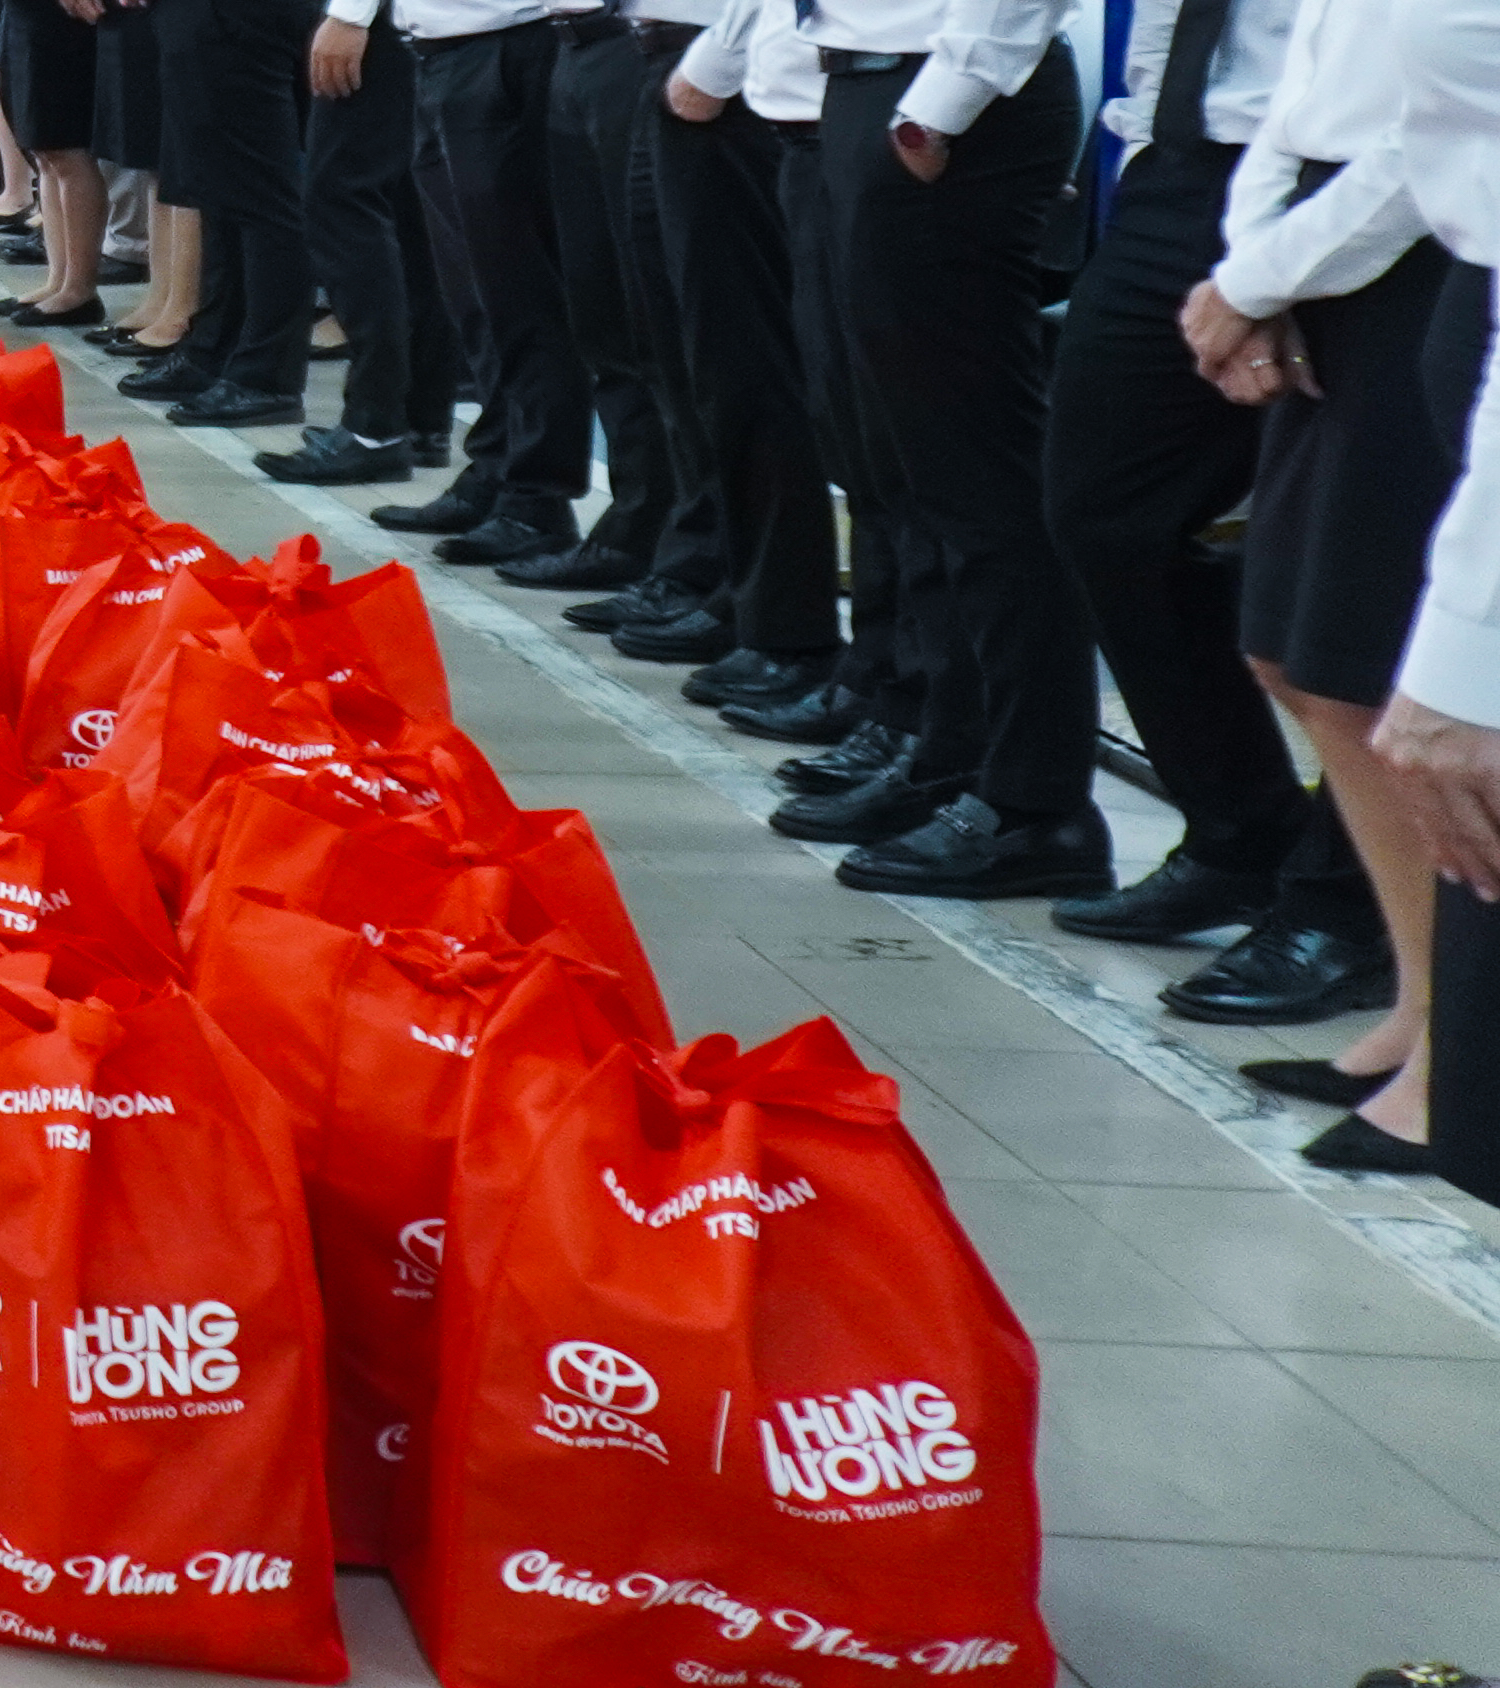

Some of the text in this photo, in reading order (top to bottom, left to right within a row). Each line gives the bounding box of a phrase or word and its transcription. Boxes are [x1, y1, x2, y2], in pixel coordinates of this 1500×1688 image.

[76, 1299, 240, 1355] HÙNG
[182, 1397, 245, 1417] GROUP
[540, 1393, 668, 1456] TOYOTA
[777, 1380, 957, 1452] HÙNG
[774, 1500, 852, 1523] TOYOTA
[920, 1488, 984, 1510] GROUP
[63, 1553, 179, 1597] Năm
[501, 1549, 611, 1606] Chúc
